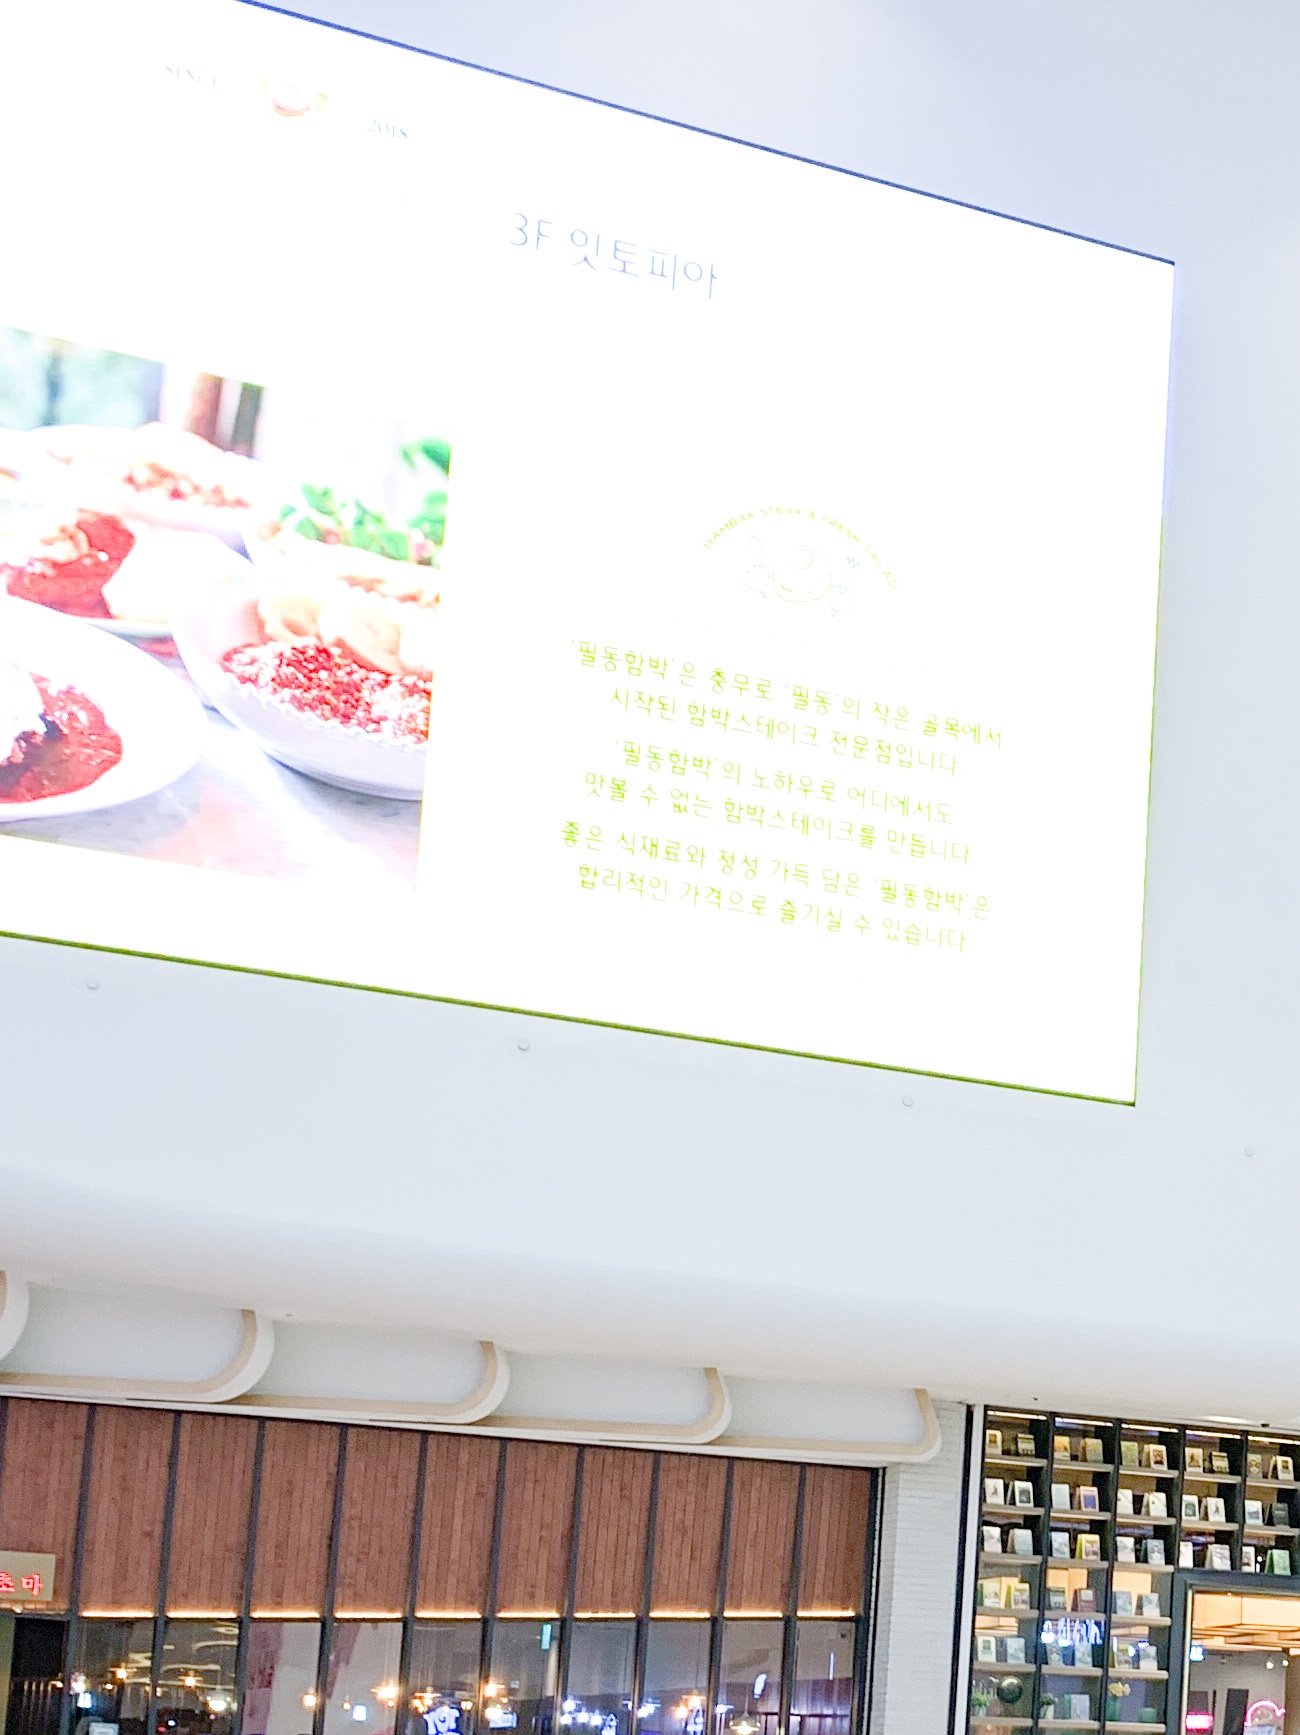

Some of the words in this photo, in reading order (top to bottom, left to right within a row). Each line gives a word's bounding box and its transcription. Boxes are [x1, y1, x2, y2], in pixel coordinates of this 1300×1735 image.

[509, 212, 552, 250] 3F
[570, 228, 718, 301] 잇토피아
[610, 688, 675, 720] 시작된
[687, 702, 817, 745] 함박스테이크
[709, 668, 770, 700] 충무로
[872, 703, 908, 730] 작은
[923, 714, 1001, 748] 골목에서
[585, 772, 628, 802] 맛볼
[640, 785, 657, 807] 수
[670, 788, 711, 816] 없는
[724, 797, 875, 848] 함박스테이크를
[751, 771, 835, 801] 노하우로
[848, 788, 949, 823] 어디에서도
[561, 821, 603, 850] 좋은
[617, 832, 706, 868] 식재료와
[719, 850, 758, 879] 정성
[772, 860, 810, 887] 가득
[822, 870, 859, 896] 담은
[579, 864, 667, 900] 합리적인
[680, 884, 766, 916] 가격으로
[779, 900, 842, 932] 즐기실
[854, 914, 869, 934] 수
